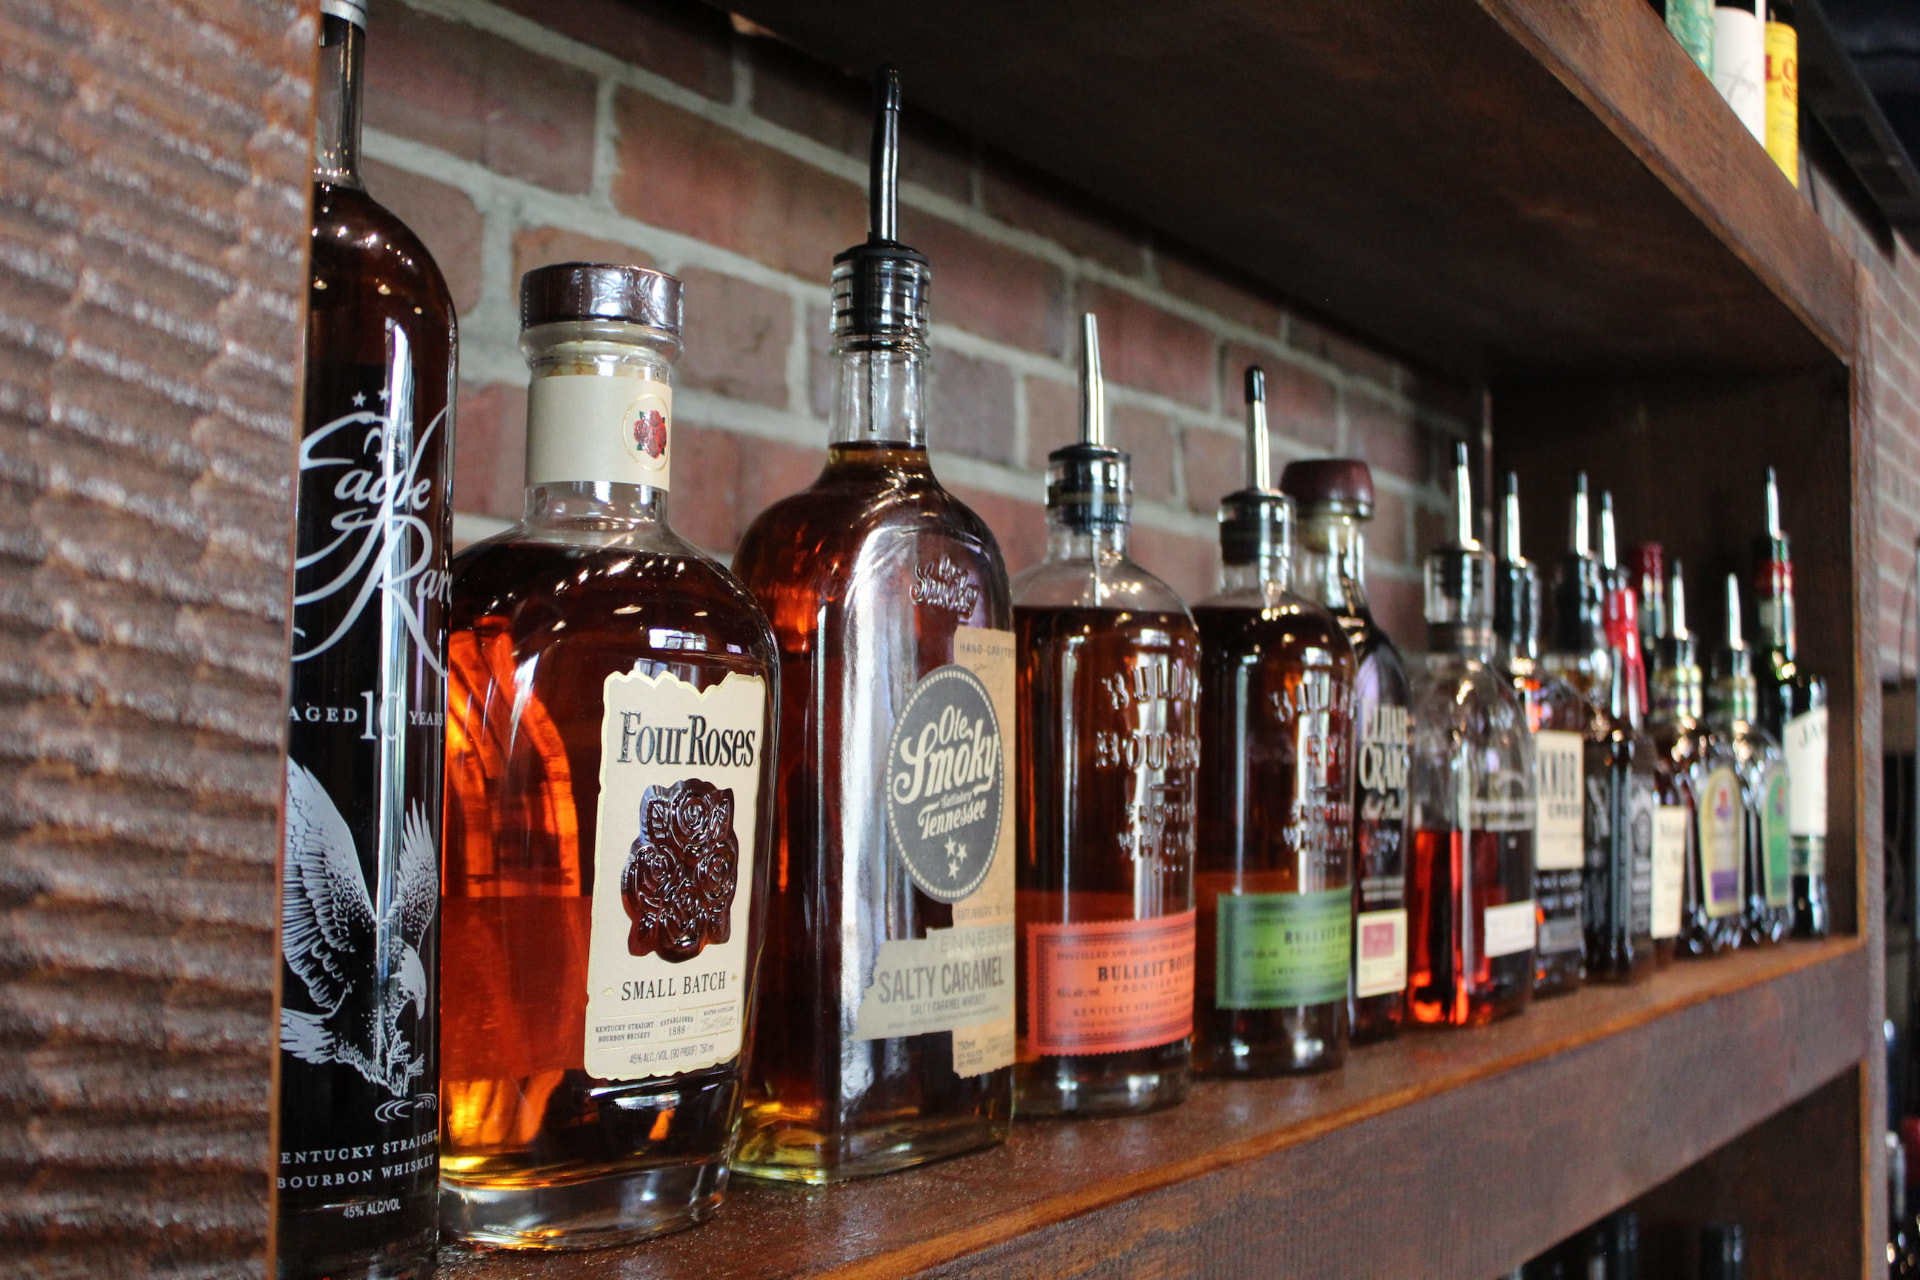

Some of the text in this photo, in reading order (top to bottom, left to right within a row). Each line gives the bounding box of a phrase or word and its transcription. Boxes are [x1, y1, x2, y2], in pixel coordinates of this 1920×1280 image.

[299, 406, 449, 512] Eagle
[288, 706, 358, 723] AGED
[360, 690, 404, 741] 10
[939, 704, 973, 745] Ole
[617, 710, 755, 768] Four Roses
[893, 719, 998, 804] Smoky
[918, 798, 987, 840] Tennessee
[621, 970, 726, 1001] SMALL BATCH
[878, 956, 1004, 1004] SALTY CARAMEL
[1098, 959, 1166, 982] BULLEIT
[595, 1021, 654, 1033] KENTUCKY STRAIGHT
[626, 1031, 650, 1041] WHISKEY
[660, 1016, 694, 1028] ESTABLISHED
[669, 1025, 686, 1037] 1888
[281, 1128, 438, 1164] ENTUCKY STRAIGHT
[276, 1153, 434, 1189] BOURBON WHISKEY
[343, 1198, 401, 1219] 45% ALC/VOL
